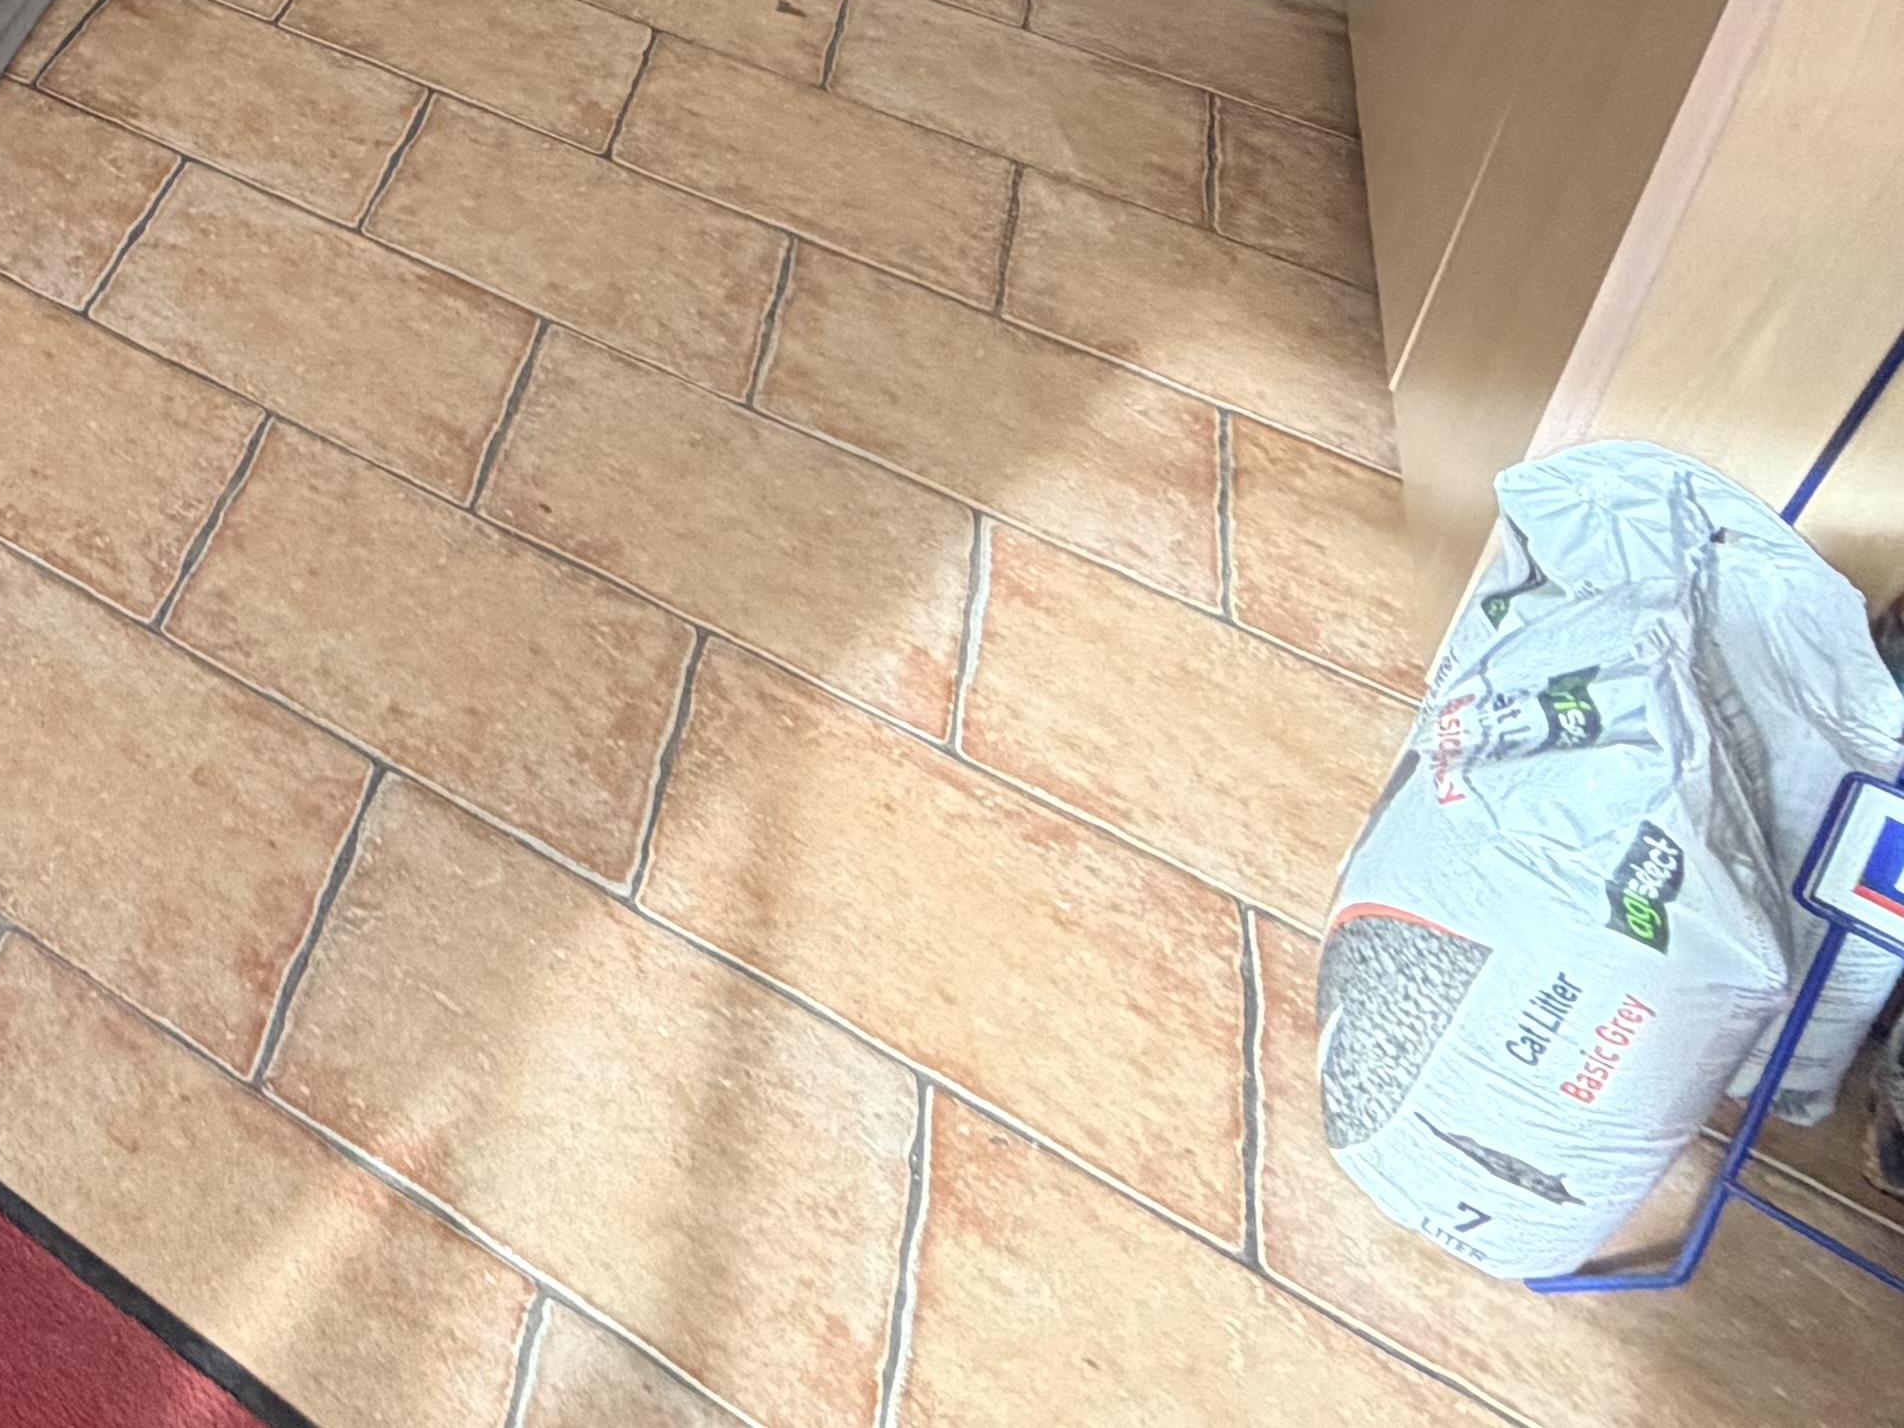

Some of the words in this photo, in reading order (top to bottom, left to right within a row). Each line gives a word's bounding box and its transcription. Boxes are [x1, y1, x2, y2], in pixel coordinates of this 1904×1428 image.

[1506, 1018, 1543, 1069] Cat
[1541, 972, 1585, 1027] Litter
[1560, 1041, 1607, 1106] Basic
[1603, 994, 1658, 1054] Grey
[1420, 1216, 1489, 1264] LITER
[1456, 1202, 1493, 1233] 7
